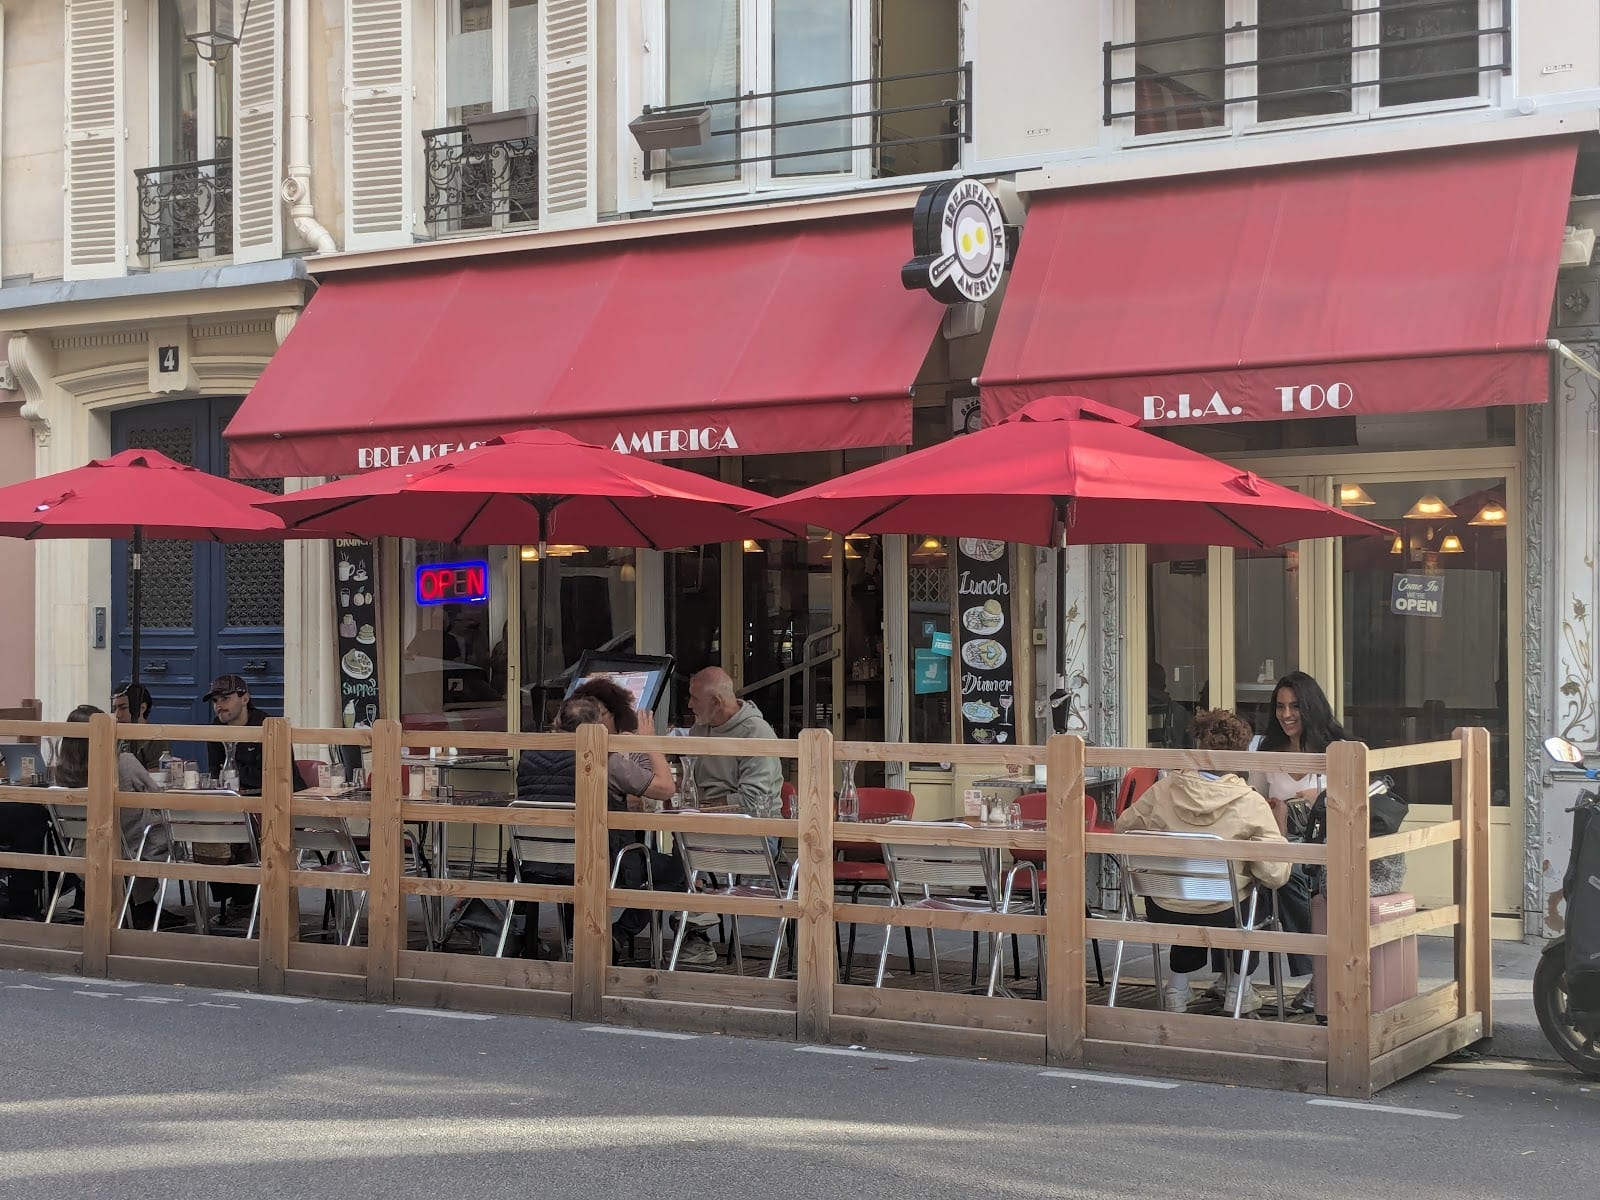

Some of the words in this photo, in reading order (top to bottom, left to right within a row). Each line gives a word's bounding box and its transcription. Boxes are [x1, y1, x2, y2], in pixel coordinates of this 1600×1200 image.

[945, 184, 996, 228] BREAKFAST
[993, 226, 1003, 248] IN
[957, 262, 1001, 297] AMERICA
[164, 349, 174, 370] 4
[1143, 391, 1243, 420] B.I.A.
[1275, 383, 1353, 412] TOO
[610, 426, 739, 455] AMERICA
[420, 567, 485, 600] OPEN
[959, 570, 1010, 596] Lunch
[1397, 577, 1424, 592] Come
[1424, 580, 1439, 592] In
[1395, 597, 1438, 613] OPEN
[343, 681, 379, 698] Supper
[961, 671, 1013, 695] Dinner
